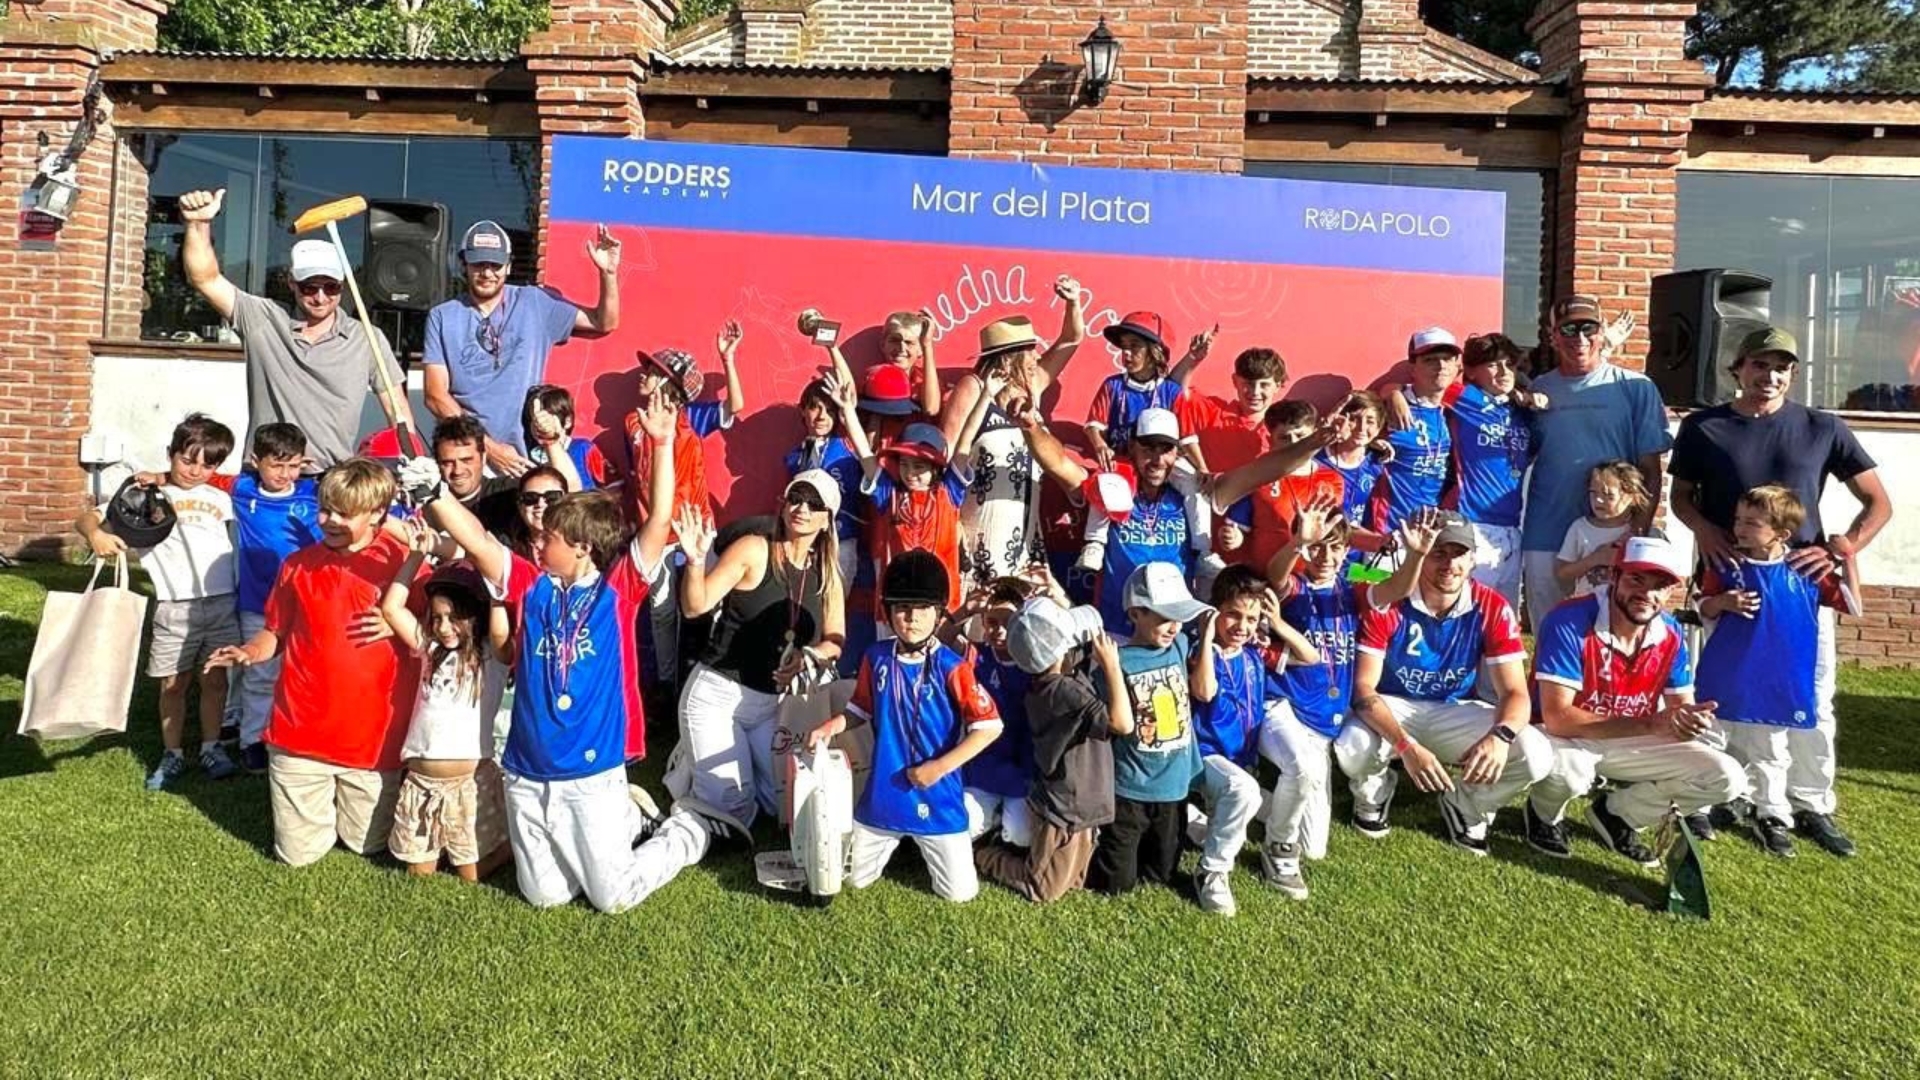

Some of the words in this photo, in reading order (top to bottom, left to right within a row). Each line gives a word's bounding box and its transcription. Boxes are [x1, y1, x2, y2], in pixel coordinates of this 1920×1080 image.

[604, 159, 731, 189] RODDERS
[603, 184, 728, 199] ACADEMY
[912, 183, 981, 213] Mar
[992, 187, 1047, 218] del
[1060, 191, 1151, 224] Plata
[1415, 419, 1428, 446] 3
[1407, 622, 1423, 656] 2
[877, 664, 888, 692] 3
